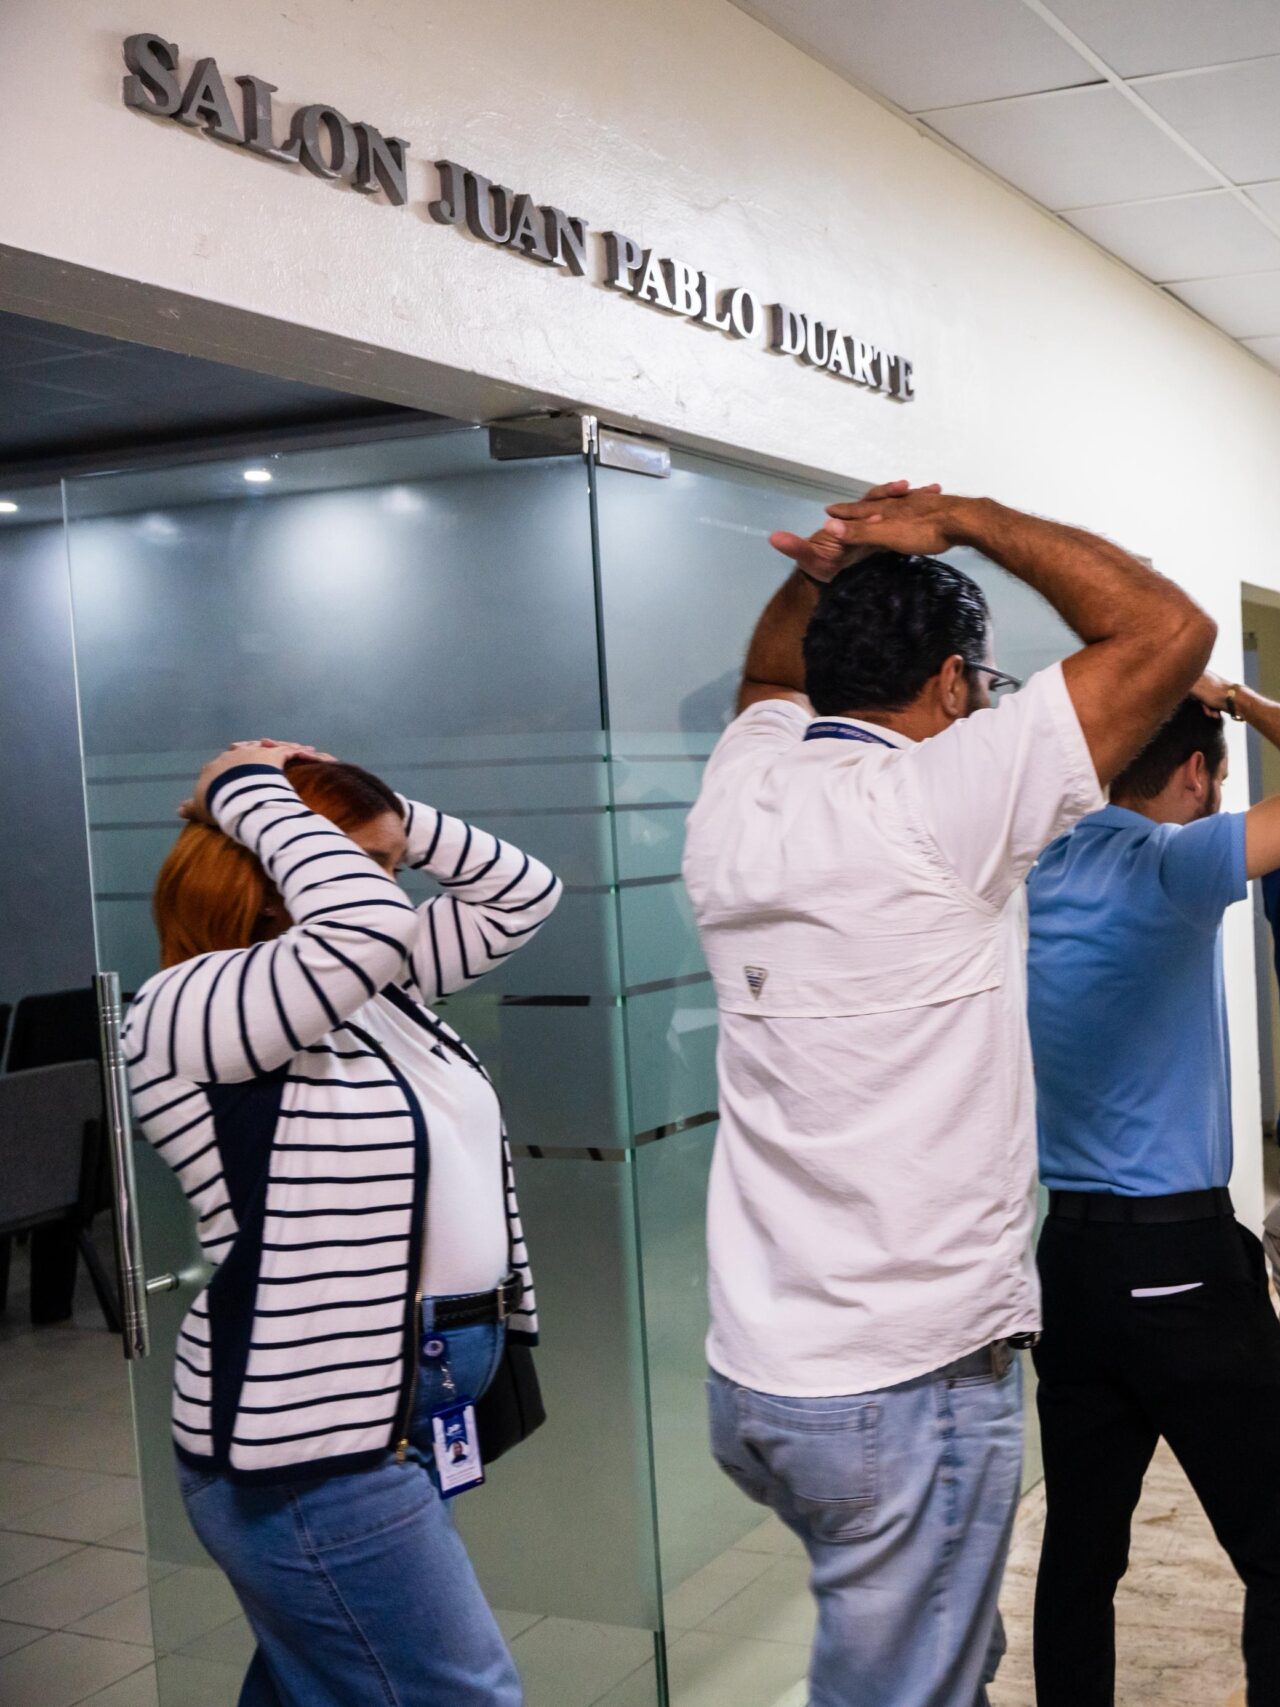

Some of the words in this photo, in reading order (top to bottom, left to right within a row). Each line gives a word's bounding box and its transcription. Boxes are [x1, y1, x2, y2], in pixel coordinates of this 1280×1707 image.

[123, 33, 410, 206] SALON
[428, 159, 588, 276] JUAN
[602, 230, 763, 340] PABLO
[771, 302, 914, 403] DUARTE
